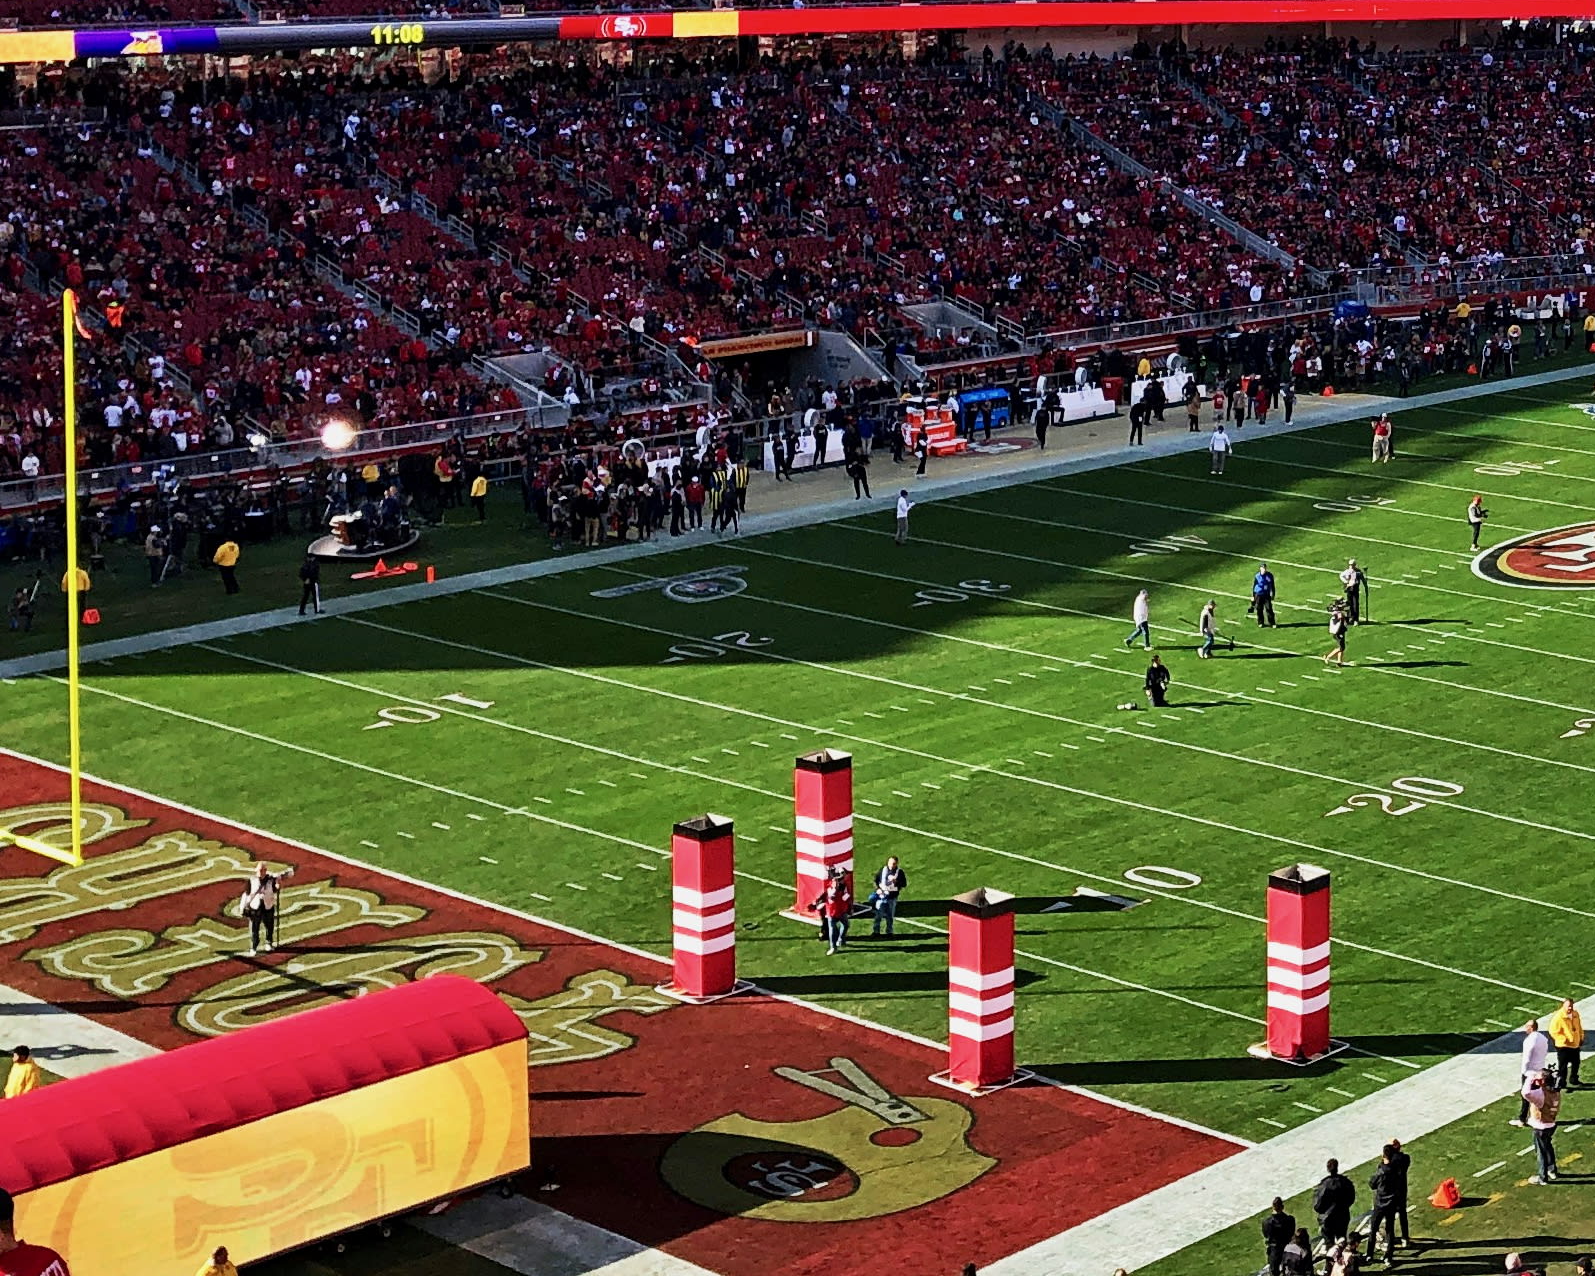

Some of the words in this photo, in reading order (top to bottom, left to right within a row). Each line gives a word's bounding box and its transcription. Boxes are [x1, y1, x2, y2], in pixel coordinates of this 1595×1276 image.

[371, 24, 423, 44] 11:08
[377, 691, 495, 724] 10
[1347, 776, 1464, 816] 20
